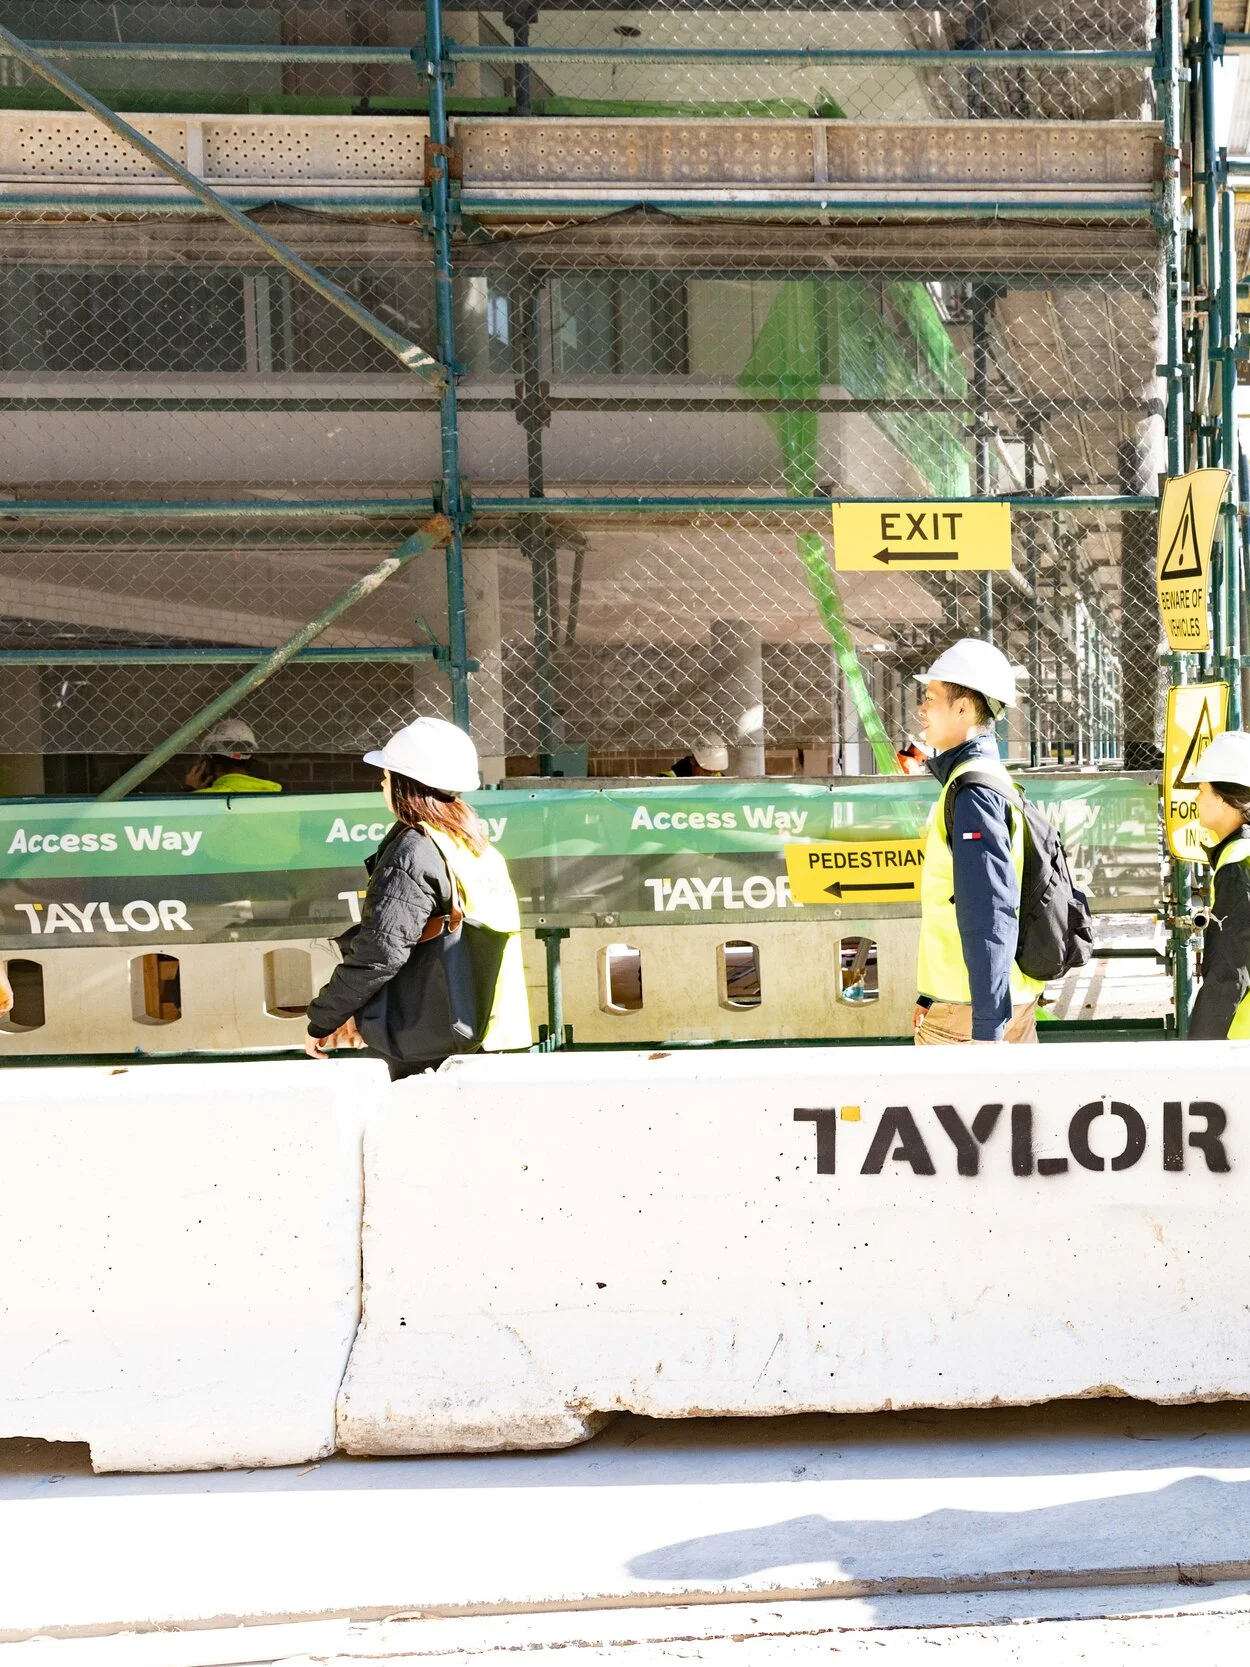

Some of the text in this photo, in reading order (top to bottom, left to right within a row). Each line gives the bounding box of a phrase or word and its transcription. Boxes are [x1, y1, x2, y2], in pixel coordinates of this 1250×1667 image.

[881, 513, 963, 540] EXIT
[1161, 588, 1203, 610] BEWARE OF
[1168, 617, 1201, 637] VEHICLES
[631, 805, 809, 833] Access Way
[1036, 799, 1101, 829] Wy
[1170, 801, 1199, 819] FOR
[7, 825, 203, 856] Access Way
[325, 818, 395, 843] Acc
[14, 899, 194, 934] TAYLOR
[793, 1100, 1232, 1177] TAYLOR
